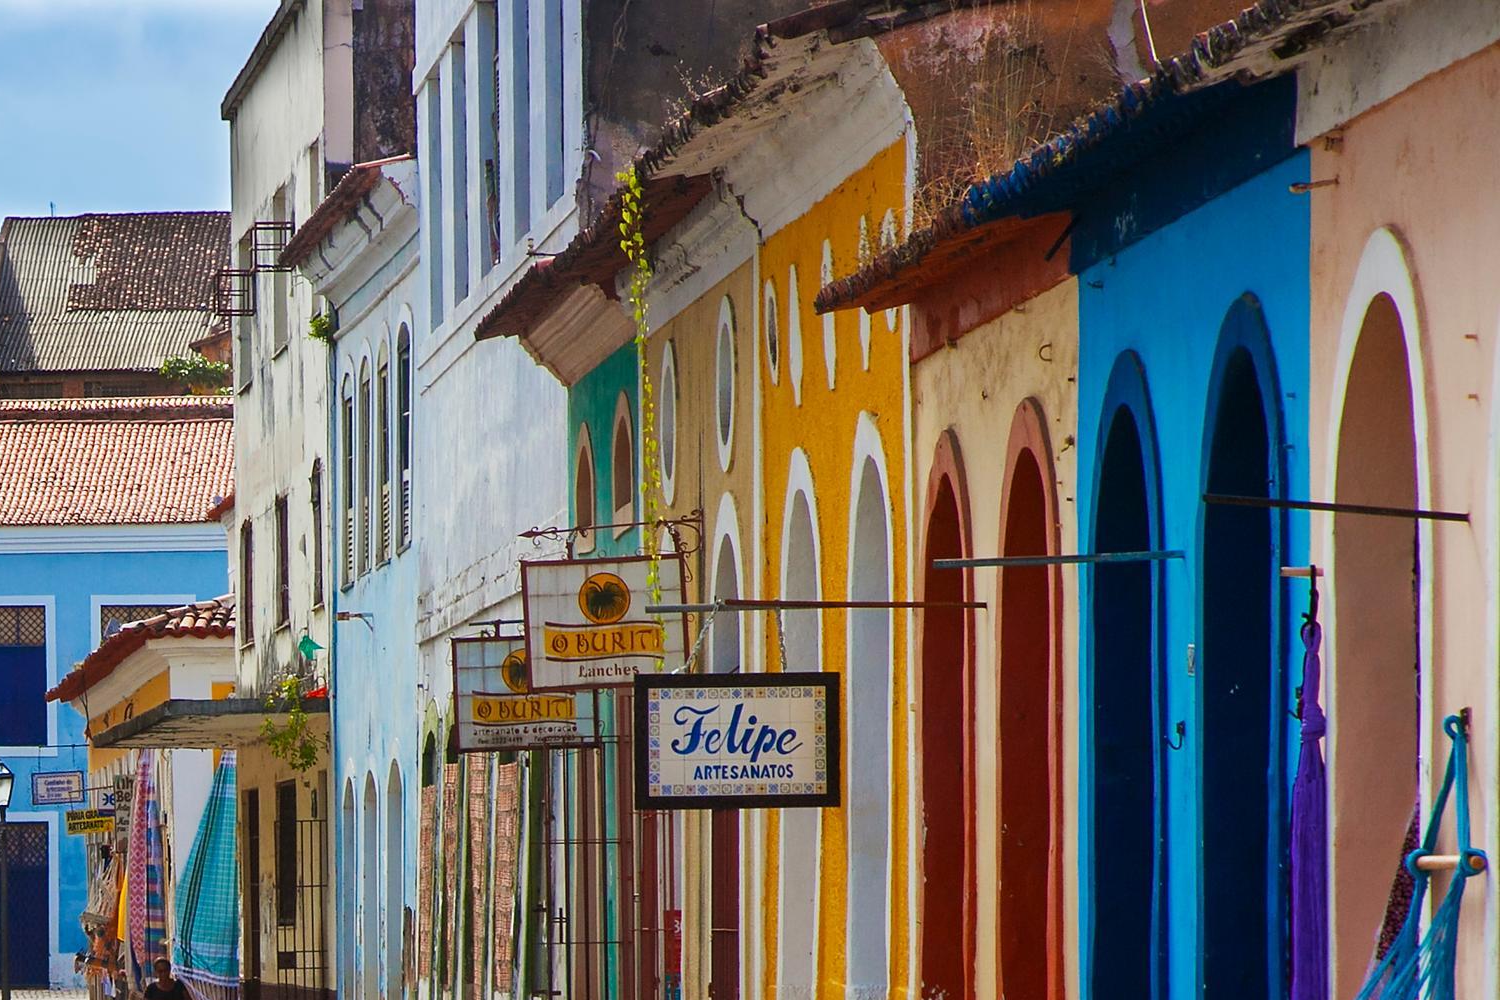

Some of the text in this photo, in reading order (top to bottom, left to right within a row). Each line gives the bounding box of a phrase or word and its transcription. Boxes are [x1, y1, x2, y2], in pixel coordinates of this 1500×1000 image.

[552, 629, 660, 654] O BURITI
[578, 664, 640, 678] Lanches
[477, 698, 573, 719] O BURITI
[473, 727, 520, 736] artesanato
[670, 703, 803, 763] Felipe
[693, 763, 794, 781] ARTESANATOS
